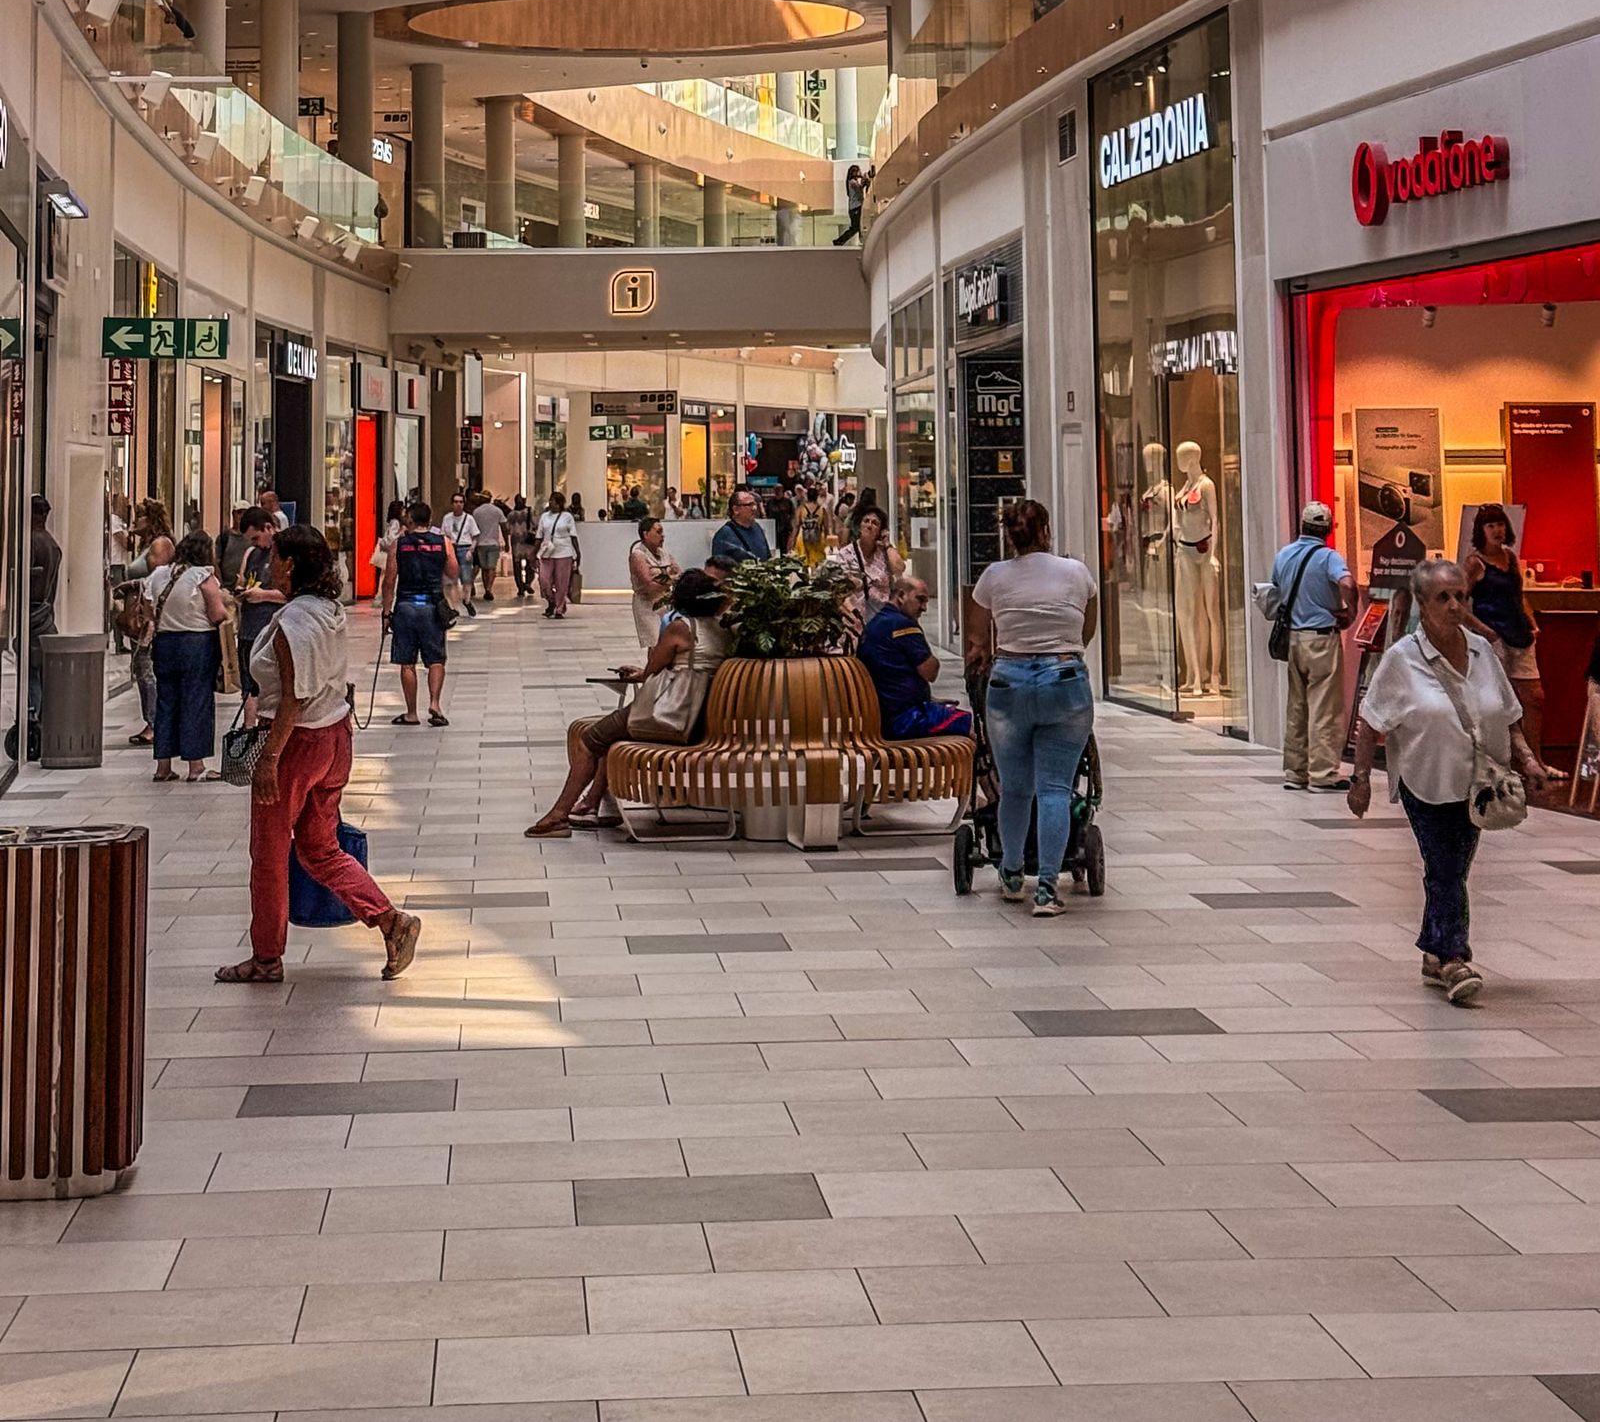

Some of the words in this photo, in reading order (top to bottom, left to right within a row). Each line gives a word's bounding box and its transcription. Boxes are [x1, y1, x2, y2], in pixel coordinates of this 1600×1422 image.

[1100, 92, 1209, 189] CALZEDONIA
[1384, 130, 1509, 203] vodafone
[287, 341, 318, 380] DECIMAS
